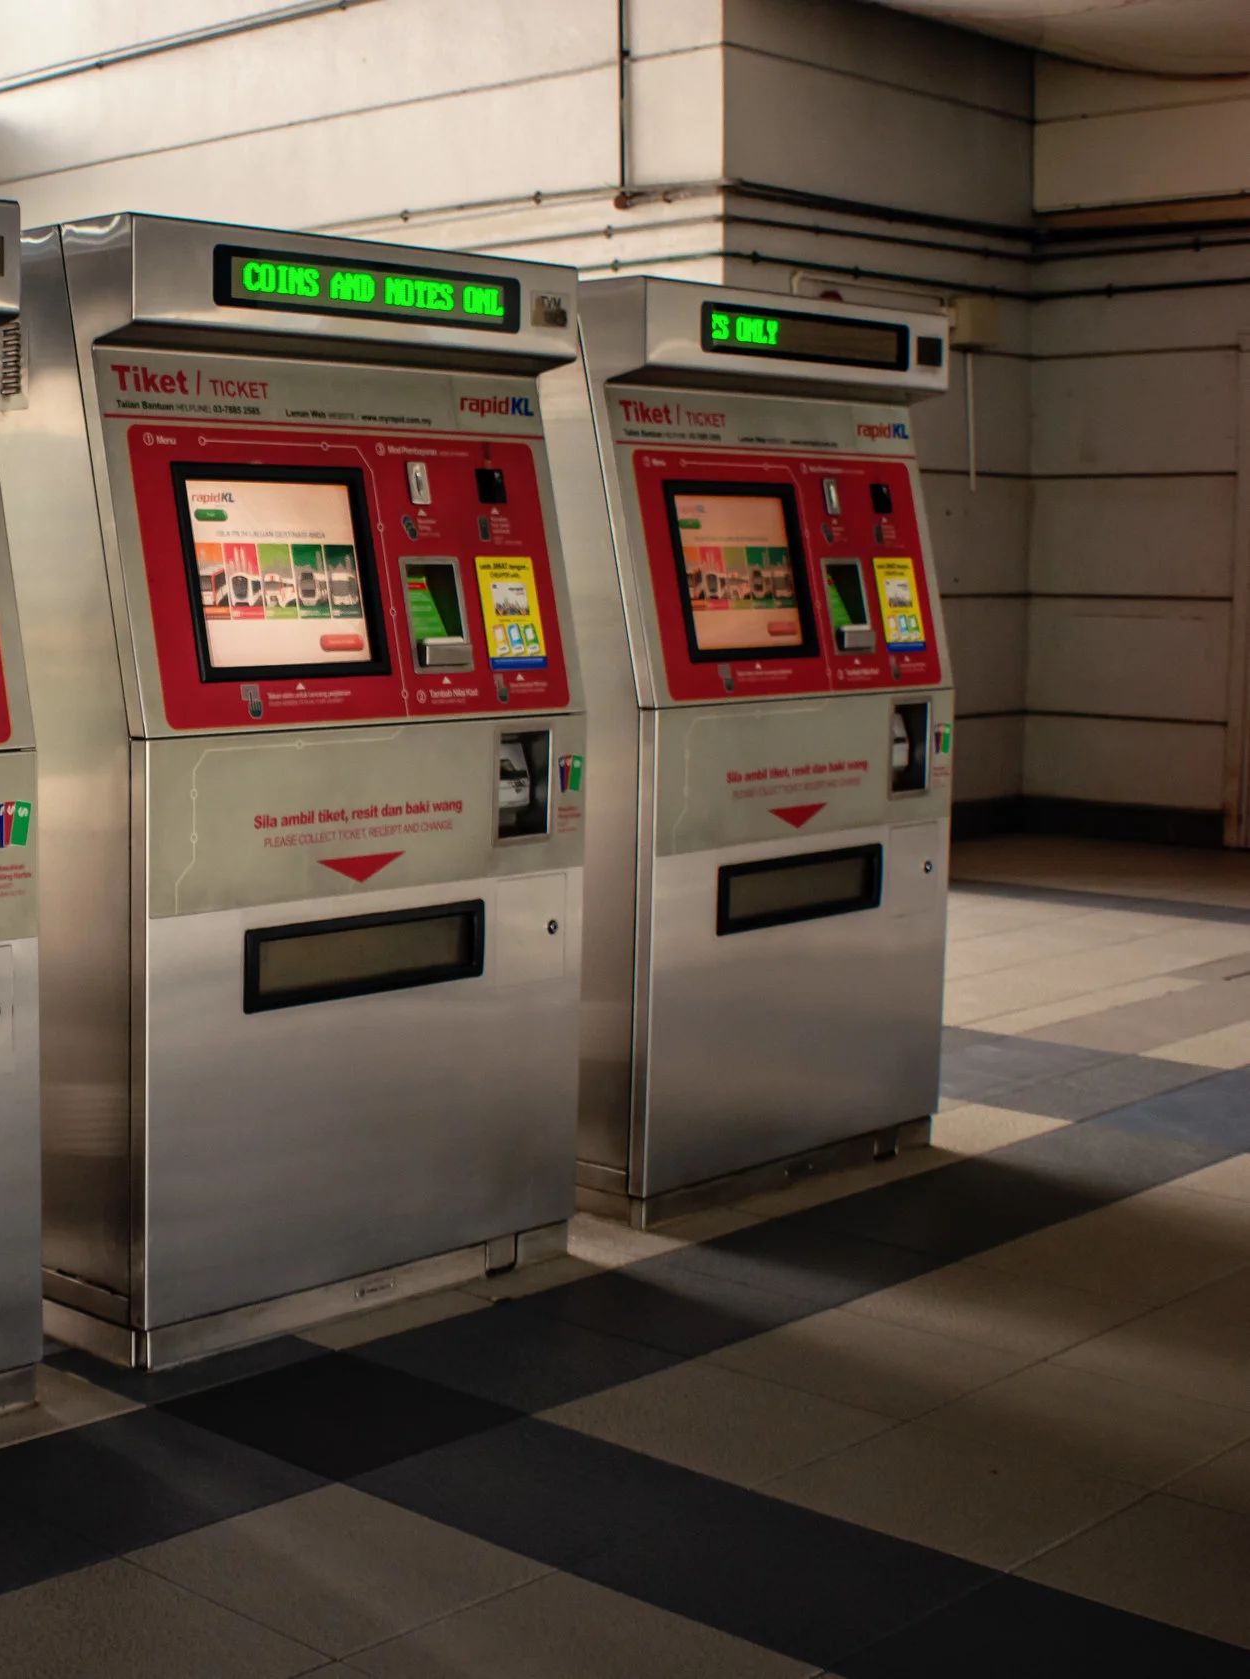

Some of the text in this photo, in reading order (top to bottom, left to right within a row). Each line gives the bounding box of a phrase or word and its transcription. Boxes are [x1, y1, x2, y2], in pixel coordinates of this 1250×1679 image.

[242, 261, 321, 298] COINS
[329, 271, 376, 304] AND
[384, 276, 455, 311] NOTES
[735, 316, 779, 345] ONLY
[111, 364, 189, 395] Tiket
[209, 379, 269, 399] TICKET
[142, 401, 174, 411] Bantuan
[459, 396, 534, 418] rapidKL
[618, 399, 673, 426] Tiket
[686, 410, 726, 428] TICKET
[156, 435, 177, 446] Menu
[857, 423, 909, 442] rapidKL
[254, 799, 463, 830] Sila ambil tiket, resit dan baki wang
[263, 834, 297, 848] PLEASE
[299, 830, 336, 845] COLLECT
[403, 822, 420, 834] AND
